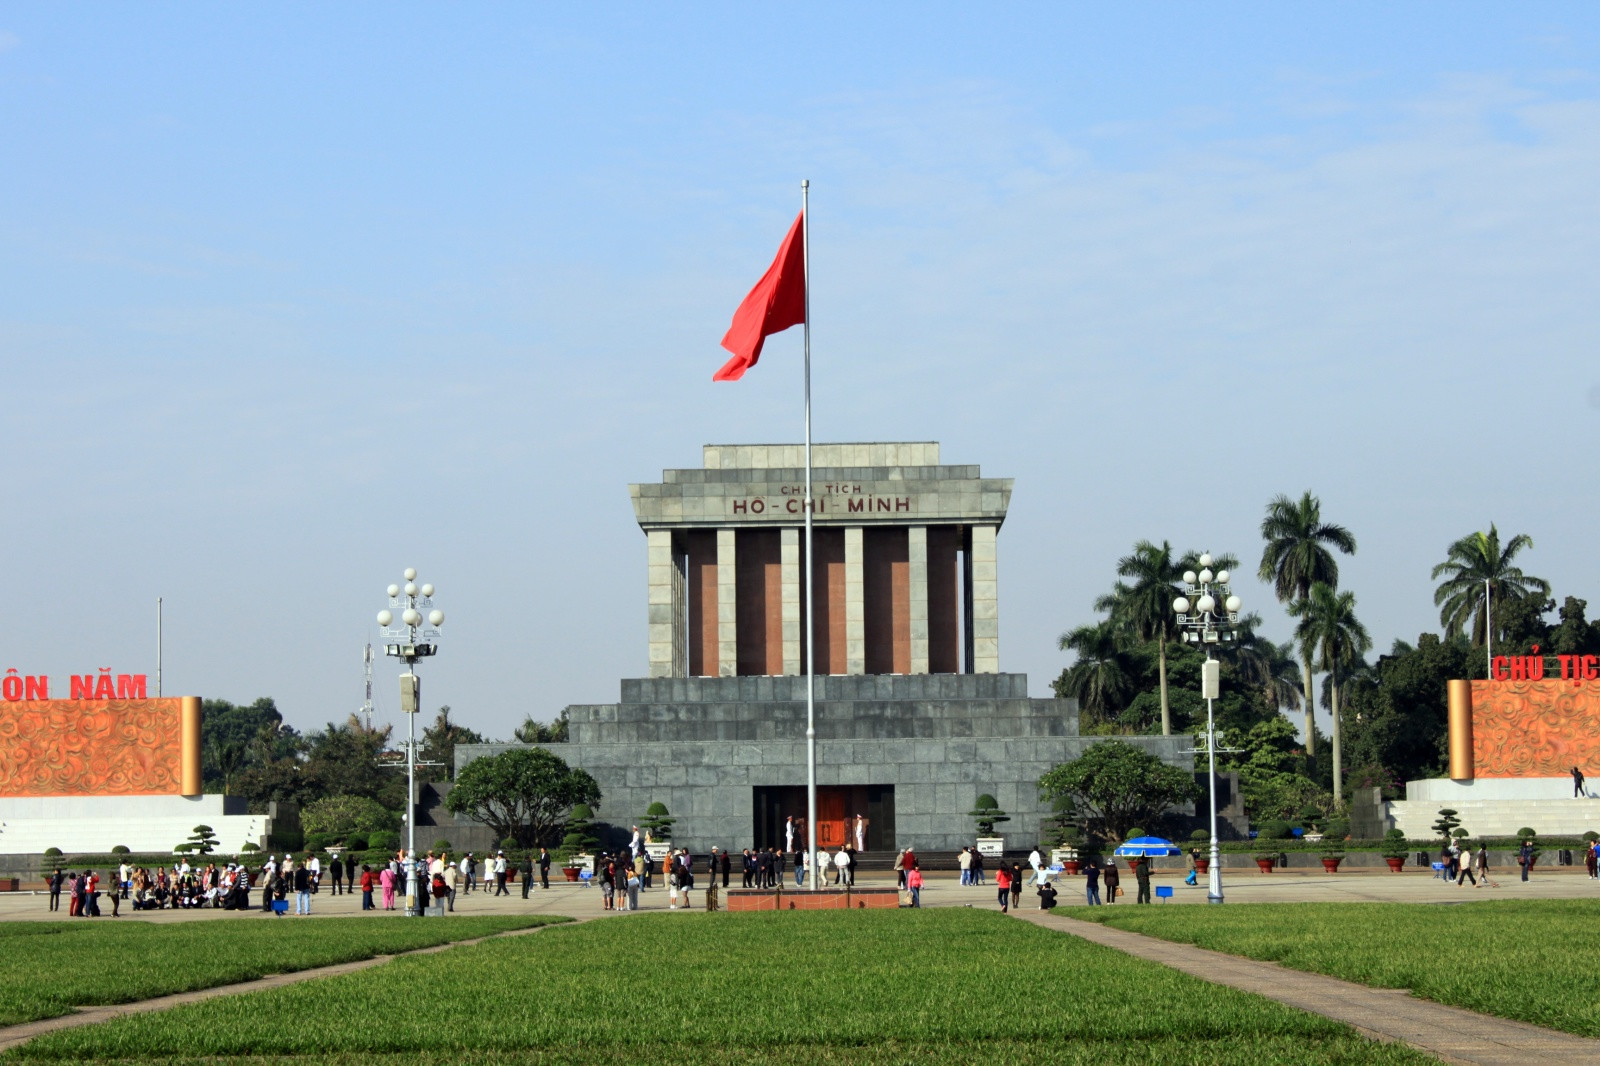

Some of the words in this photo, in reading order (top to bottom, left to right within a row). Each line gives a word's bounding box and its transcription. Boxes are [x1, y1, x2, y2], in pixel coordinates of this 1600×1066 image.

[781, 485, 812, 495] CH
[1492, 644, 1544, 681] CHỦ
[70, 667, 148, 700] NĂM
